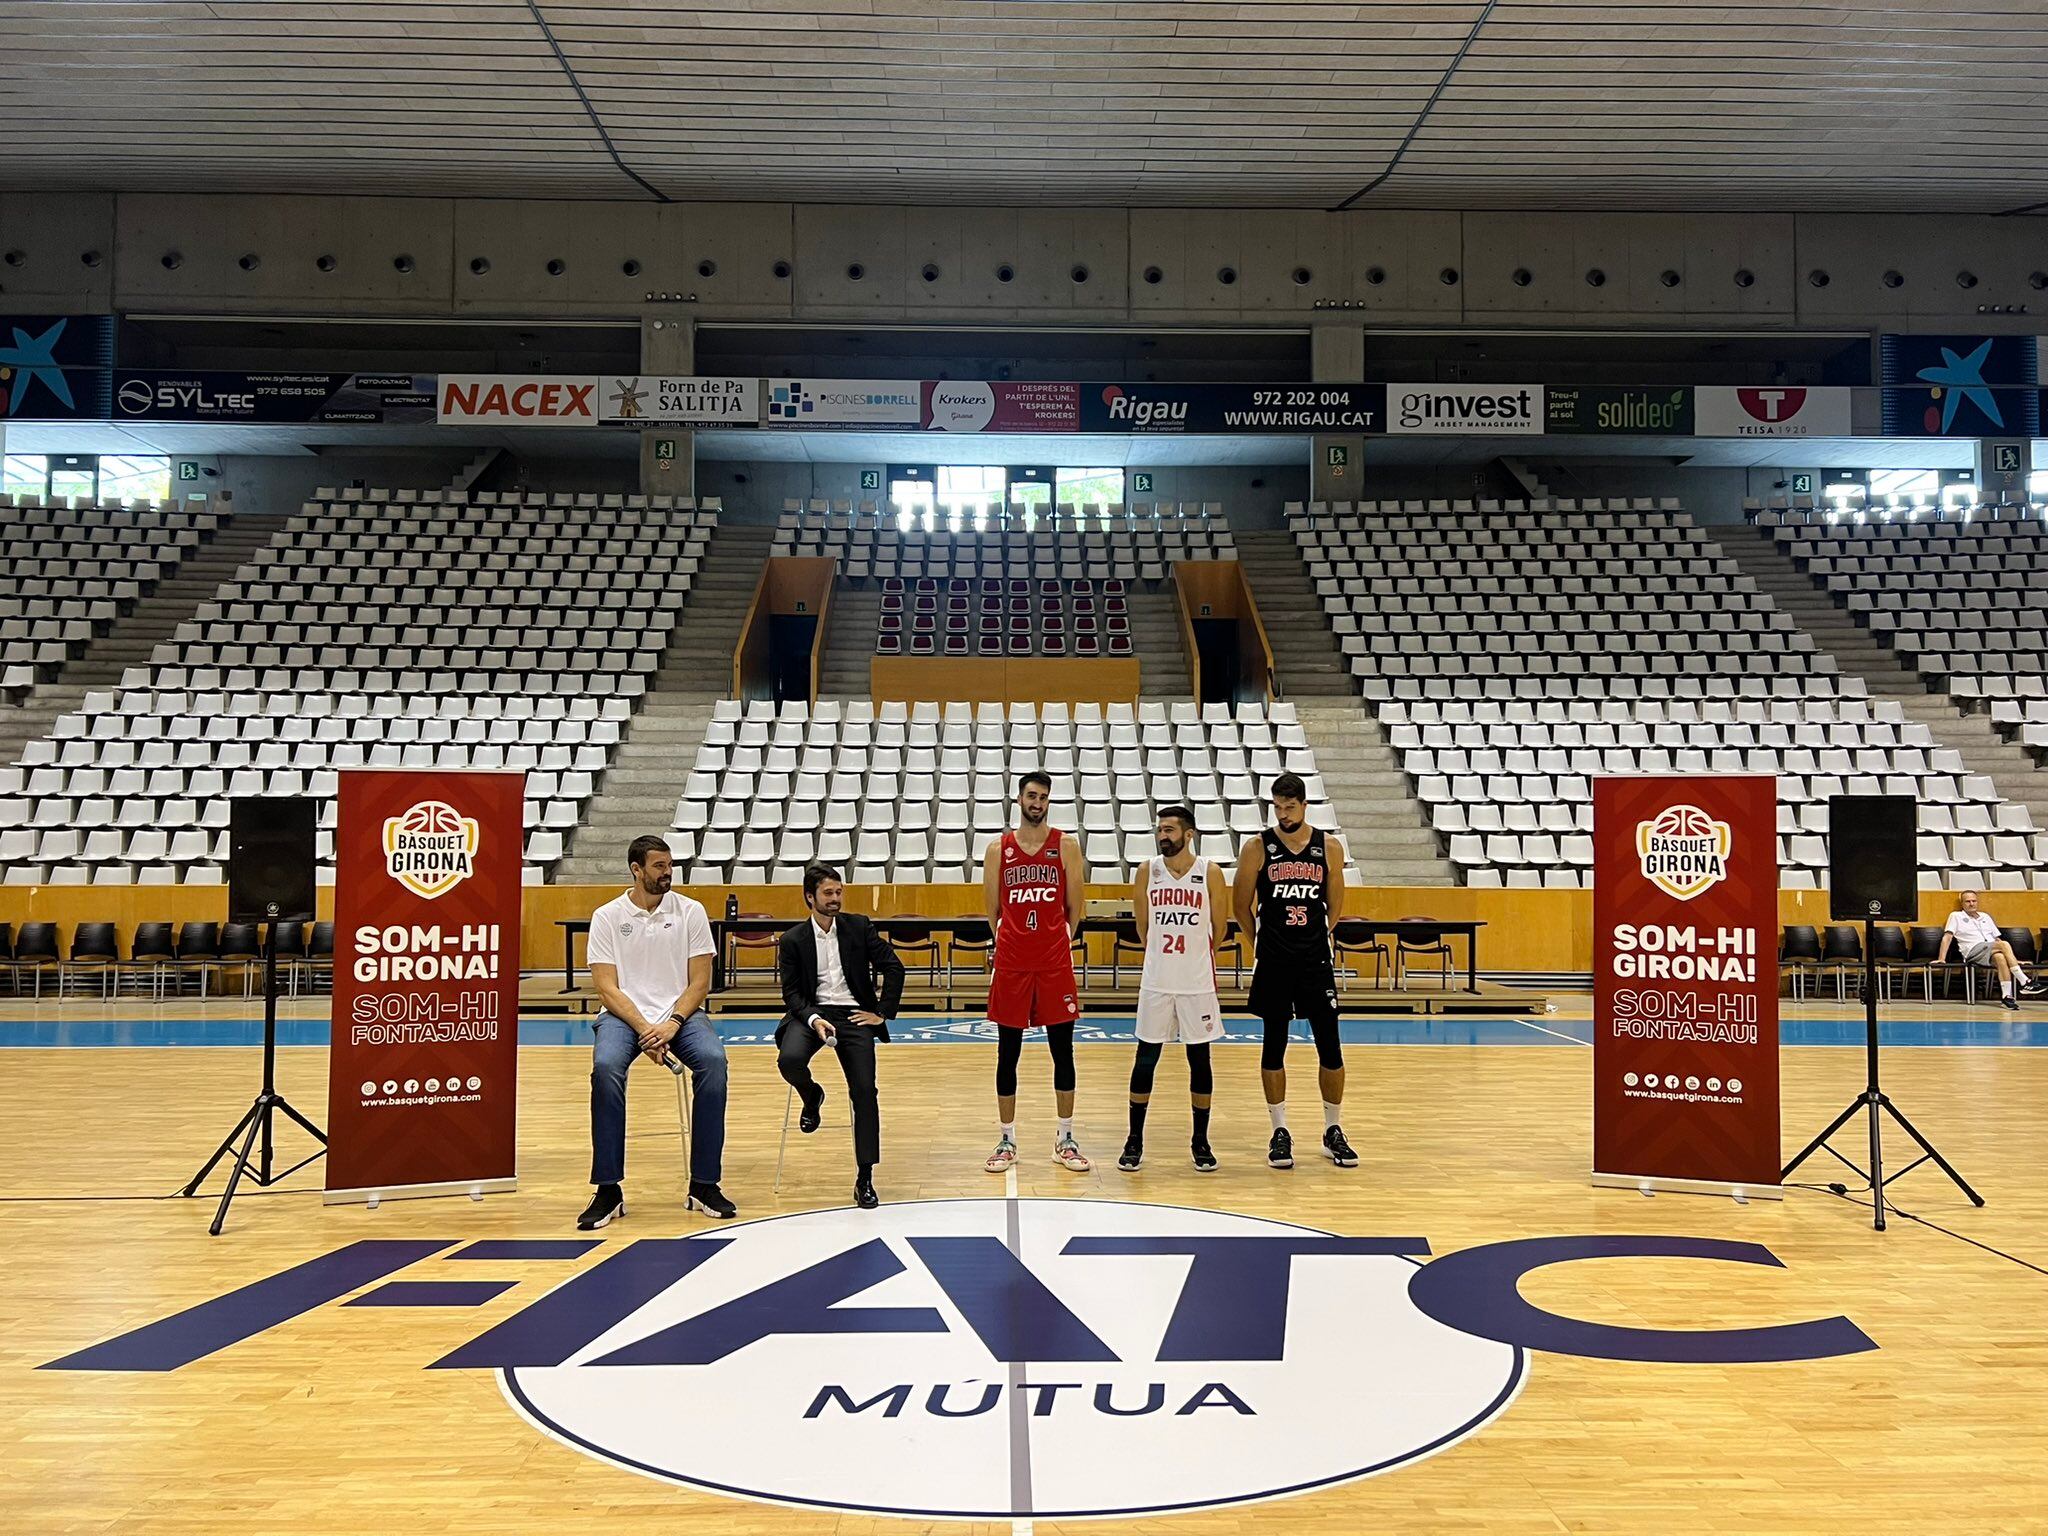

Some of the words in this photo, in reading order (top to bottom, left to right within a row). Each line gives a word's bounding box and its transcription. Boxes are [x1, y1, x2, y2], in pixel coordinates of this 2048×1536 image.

[256, 387, 278, 395] 972
[280, 387, 302, 396] 658
[303, 387, 326, 396] 505
[659, 379, 696, 393] Forn
[701, 380, 720, 393] de
[725, 380, 743, 394] Pa
[1005, 393, 1034, 401] PARTIT
[1022, 383, 1058, 392] DESPRÉS
[1060, 385, 1076, 393] DEL
[443, 383, 595, 417] NACEX
[658, 395, 743, 415] SALITJA
[938, 394, 986, 405] Krokers
[1019, 402, 1063, 410] T'ESPEREM
[1253, 391, 1282, 406] 972
[1286, 391, 1316, 406] 202
[1320, 391, 1350, 406] 004
[1400, 389, 1531, 428] ginvest
[1550, 400, 1575, 410] partit
[1759, 391, 1785, 420] T
[1035, 411, 1076, 420] KROKERS!
[1109, 396, 1188, 426] Rigau
[1224, 411, 1374, 426] WWW.RIGAU.CAT
[1598, 392, 1673, 428] solideo
[1738, 426, 1774, 434] TEISA
[1779, 426, 1807, 434] 1920
[398, 831, 465, 851] BÀSQUET
[1651, 834, 1717, 853] BÀSQUET
[392, 852, 468, 873] GIRONA
[1267, 861, 1323, 884] GIRONA
[1646, 854, 1721, 876] GIRONA
[1003, 864, 1060, 887] GIRONA
[1009, 887, 1057, 905] FIATC
[1150, 888, 1203, 910] GIRONA
[1272, 884, 1320, 899] FIATC
[1025, 909, 1037, 931] 4
[1155, 911, 1200, 926] FIATC
[1285, 905, 1308, 926] 35
[354, 924, 500, 955] SOM-HI
[1162, 934, 1186, 954] 24
[1612, 923, 1756, 955] SOM-HI
[353, 954, 499, 982] GIRONA!
[1612, 953, 1756, 982] GIRONA!
[351, 990, 499, 1023] SOM-HI
[1612, 989, 1757, 1023] SOM-HI
[351, 1020, 498, 1046] FONTAJAU!
[1612, 1018, 1758, 1045] FONTAJAU!
[360, 1093, 482, 1107] www.basquetgirona.com
[1623, 1089, 1743, 1104] www.basquetgirona.com
[33, 1236, 1881, 1372] FIATC
[804, 1377, 1257, 1420] MÚTUA
